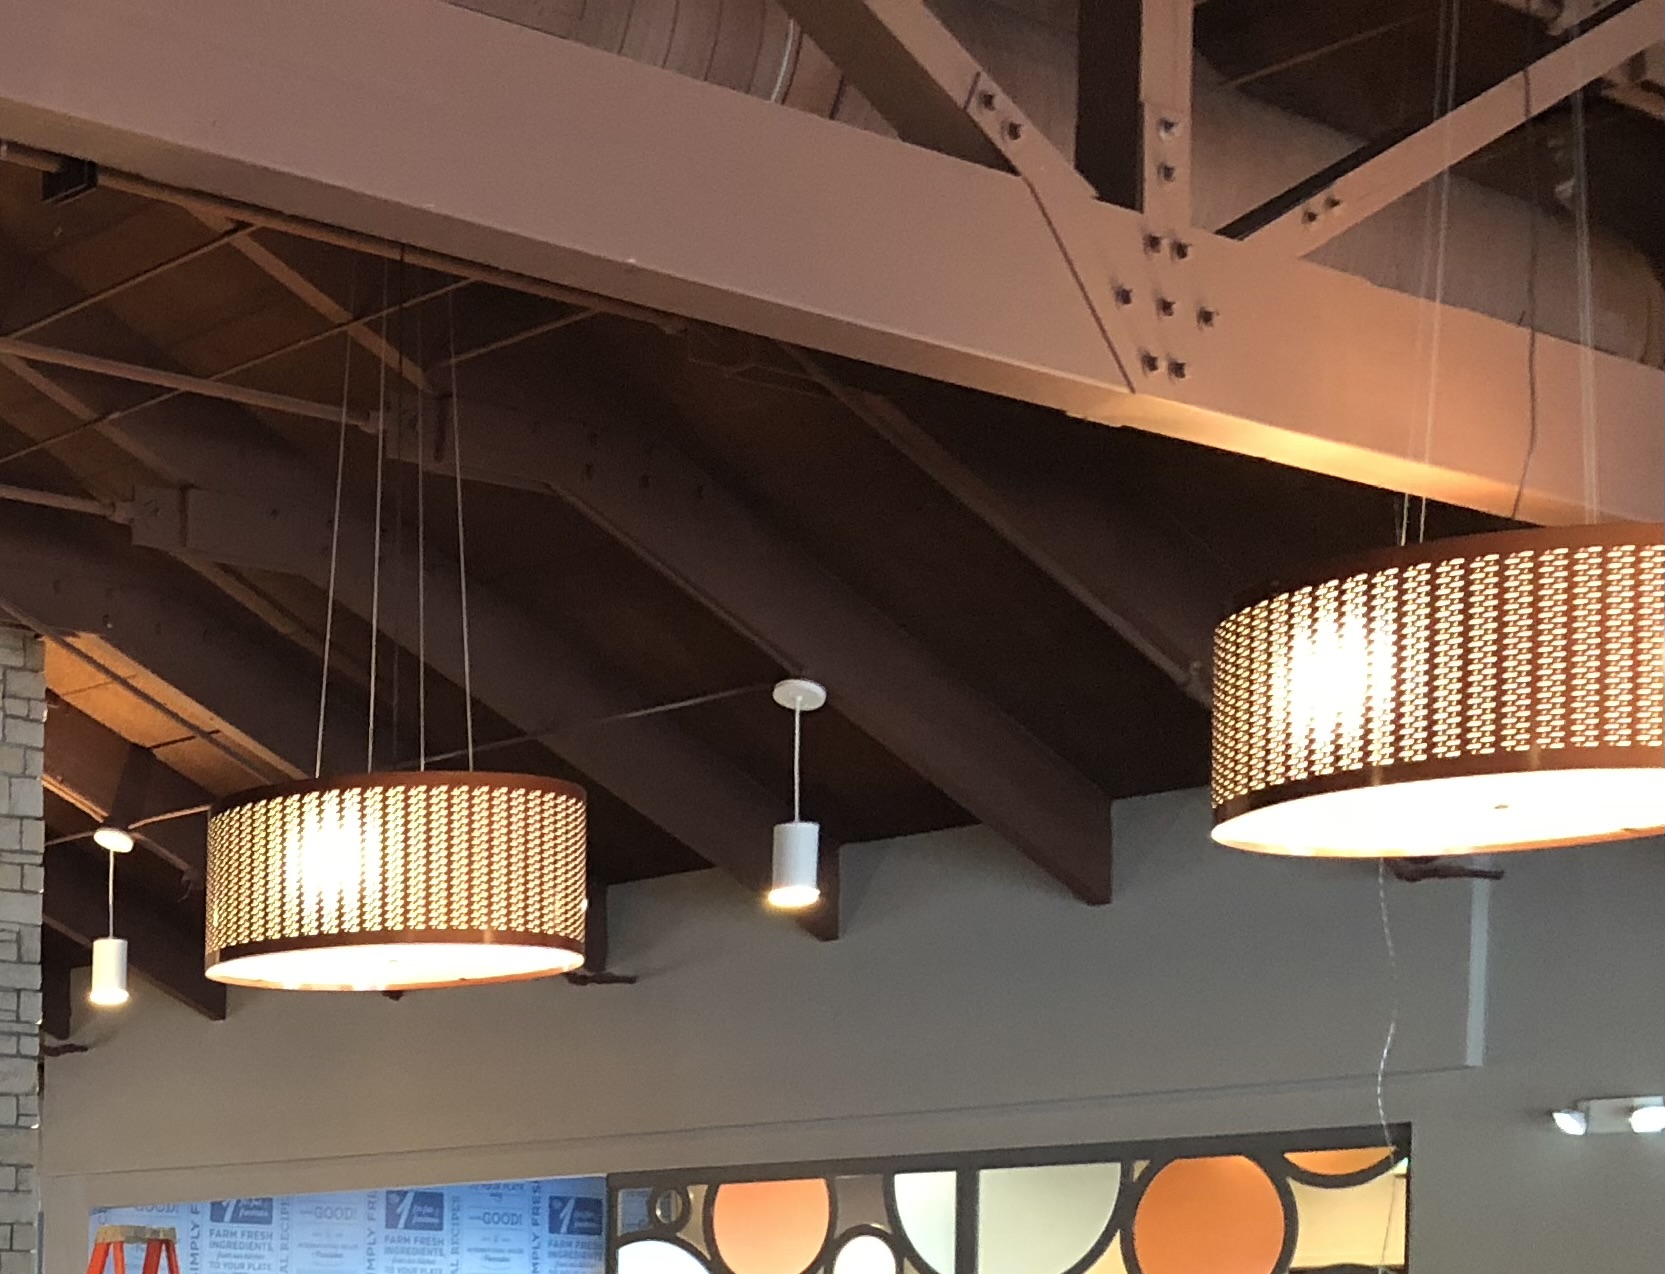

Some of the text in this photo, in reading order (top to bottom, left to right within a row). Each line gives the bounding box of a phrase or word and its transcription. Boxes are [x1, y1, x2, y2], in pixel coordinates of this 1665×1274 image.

[314, 1206, 357, 1220] GOOD!
[481, 1211, 523, 1225] GOOD!
[449, 1195, 461, 1255] RECIPES
[208, 1228, 273, 1240] FARM FRESH
[384, 1234, 445, 1246] FARM FRESH
[222, 1262, 245, 1270] YOUR
